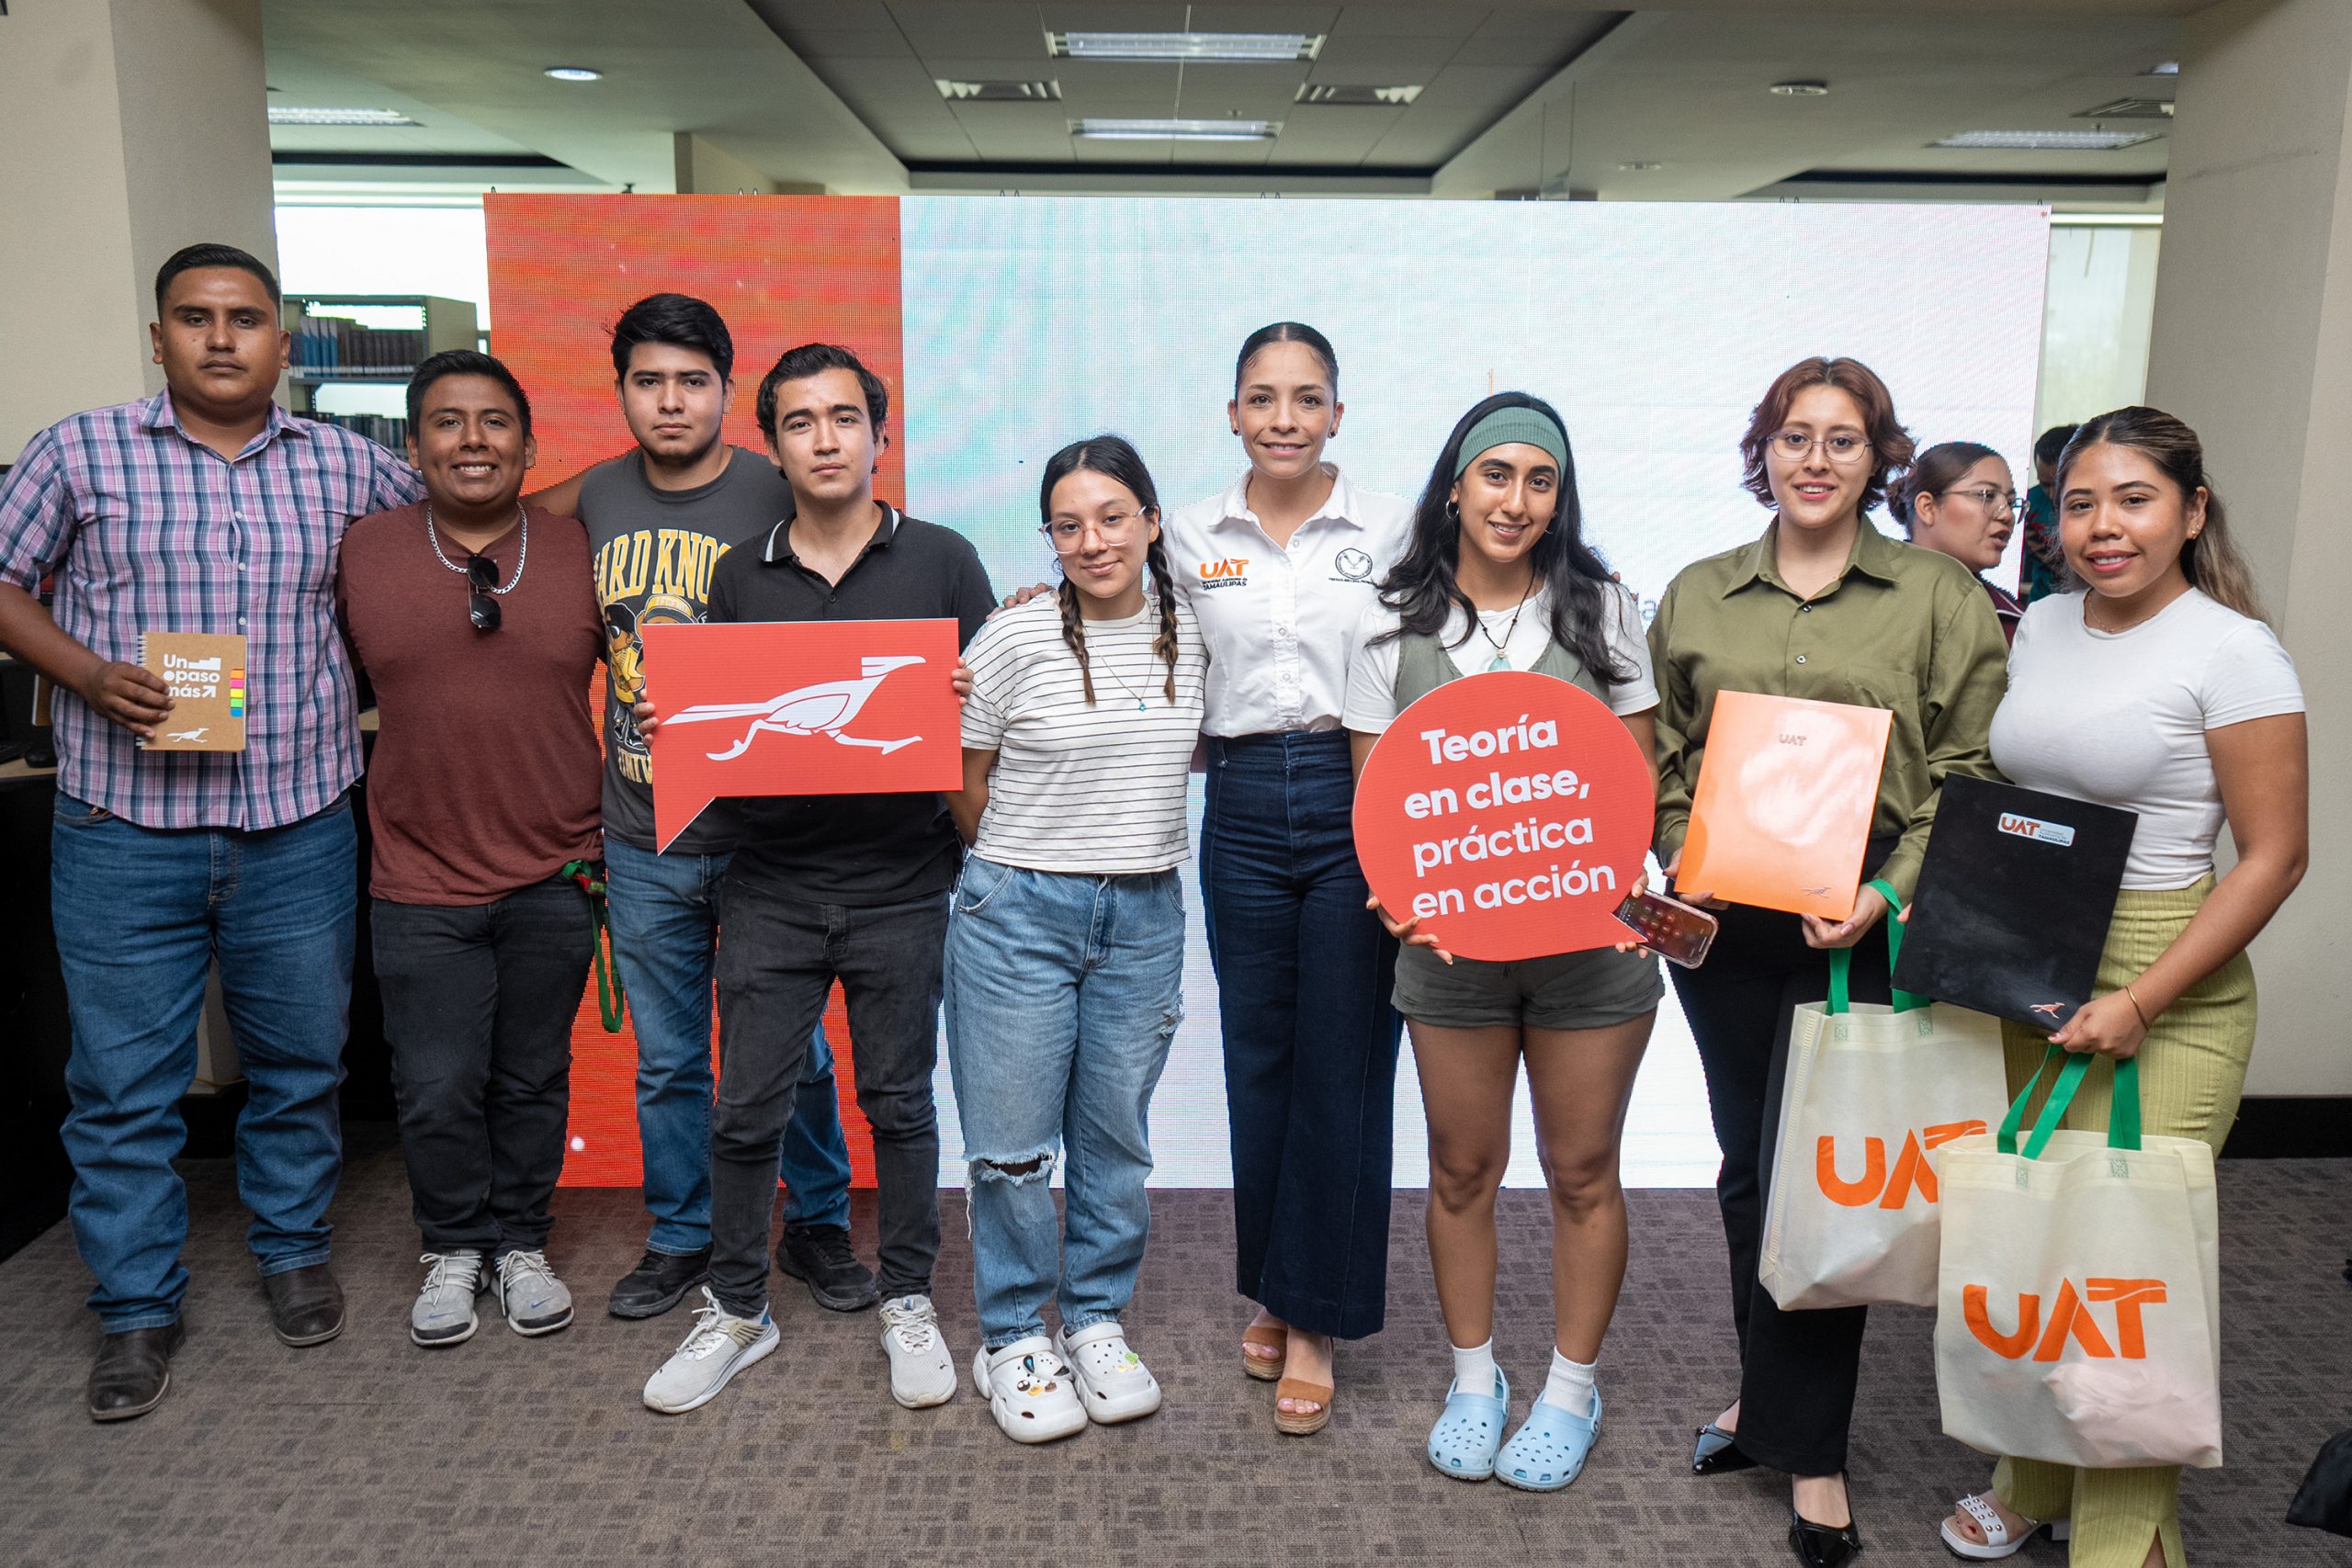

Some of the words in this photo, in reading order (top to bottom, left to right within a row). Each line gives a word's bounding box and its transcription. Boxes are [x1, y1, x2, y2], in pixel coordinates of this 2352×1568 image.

[651, 528, 732, 604] KNO
[1200, 558, 1250, 579] UAT
[163, 653, 187, 669] Un
[1420, 714, 1558, 765] Teoría
[1779, 733, 1807, 747] UAT
[1404, 787, 1459, 819] en
[1465, 769, 1590, 809] clase,
[1413, 817, 1594, 878] práctica
[2001, 817, 2041, 836] UAT
[1412, 886, 1465, 919] en
[1473, 860, 1616, 909] acción
[1962, 1277, 2168, 1362] UAT
